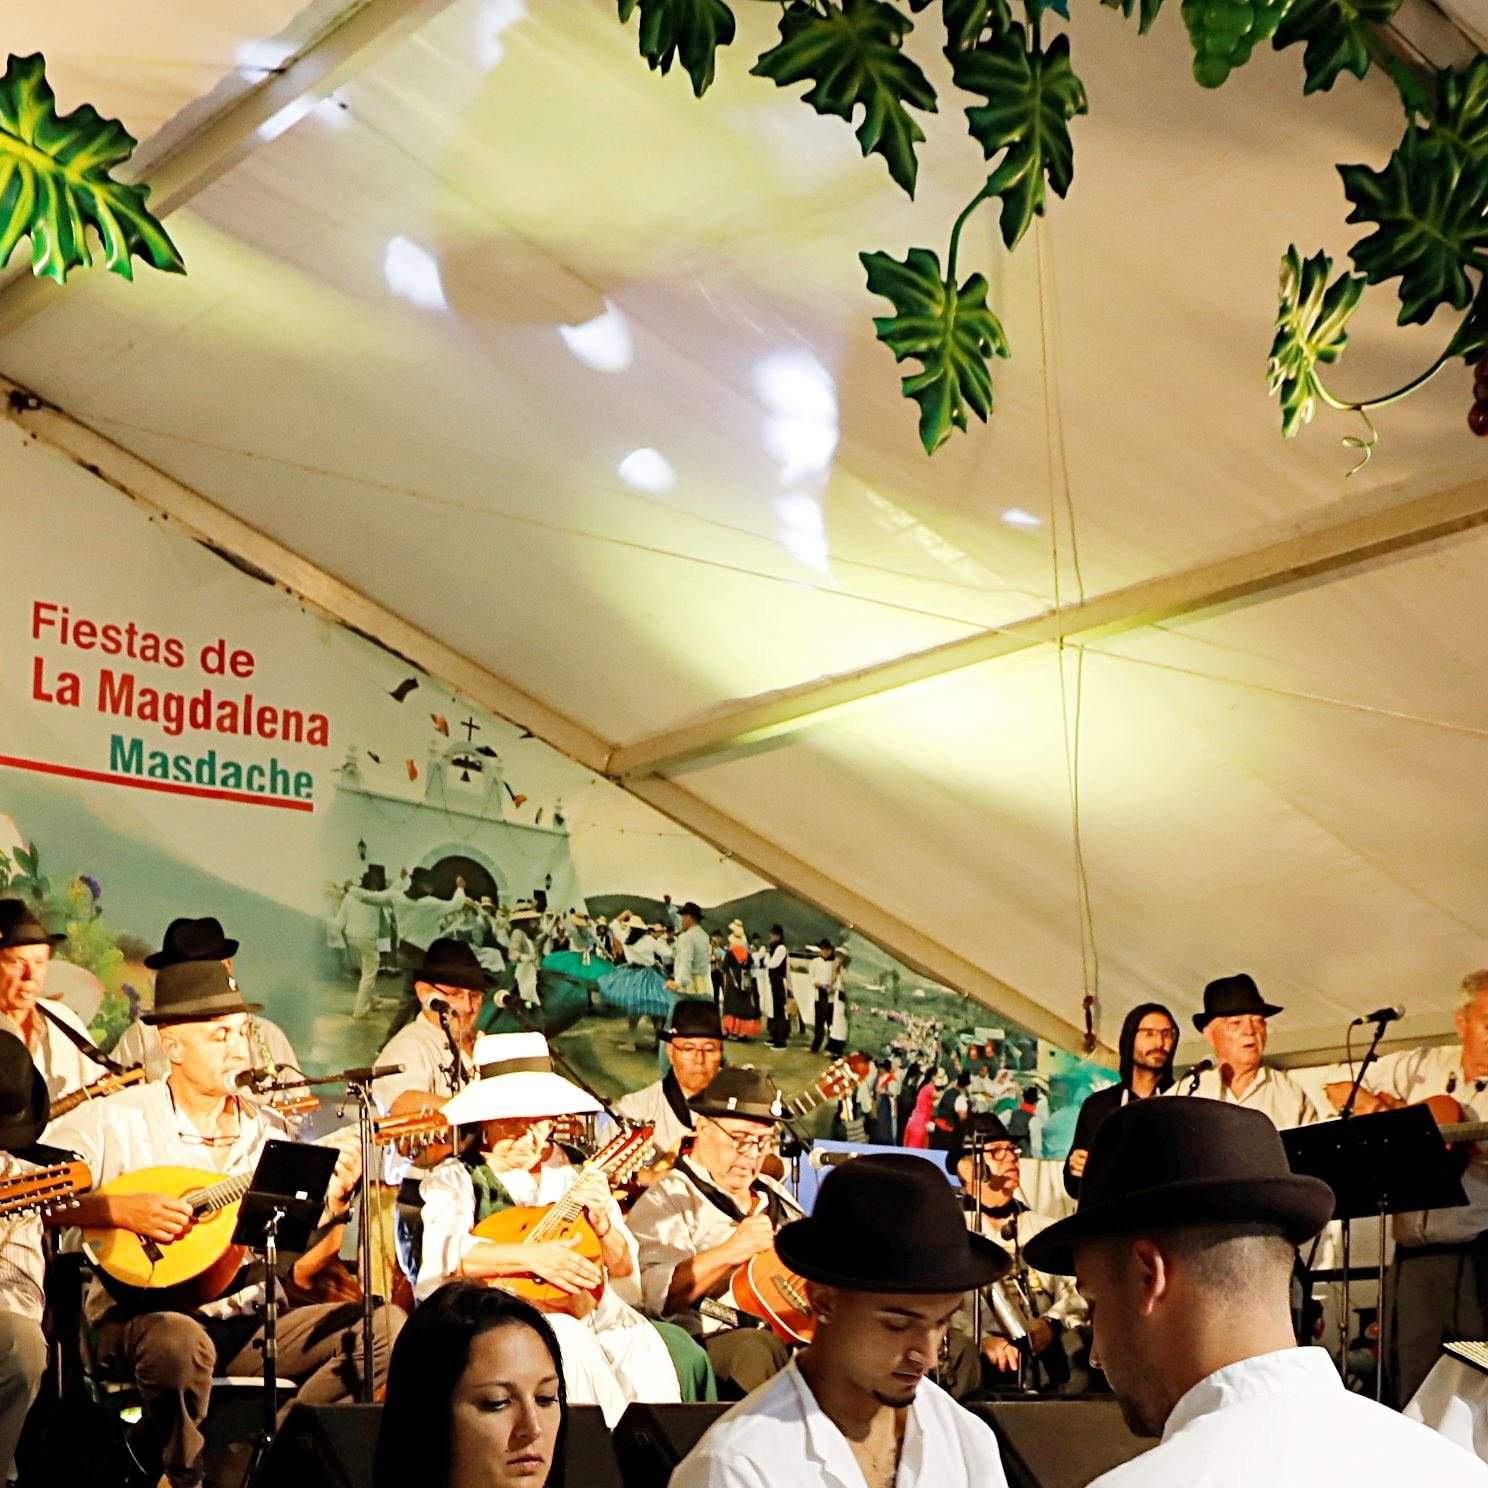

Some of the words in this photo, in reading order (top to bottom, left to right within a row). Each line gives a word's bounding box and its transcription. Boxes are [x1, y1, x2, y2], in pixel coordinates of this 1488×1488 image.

[32, 601, 184, 668] Fiestas
[200, 639, 255, 678] de
[32, 656, 81, 707] La
[98, 668, 329, 747] Magdalena
[110, 734, 314, 799] Masdache
